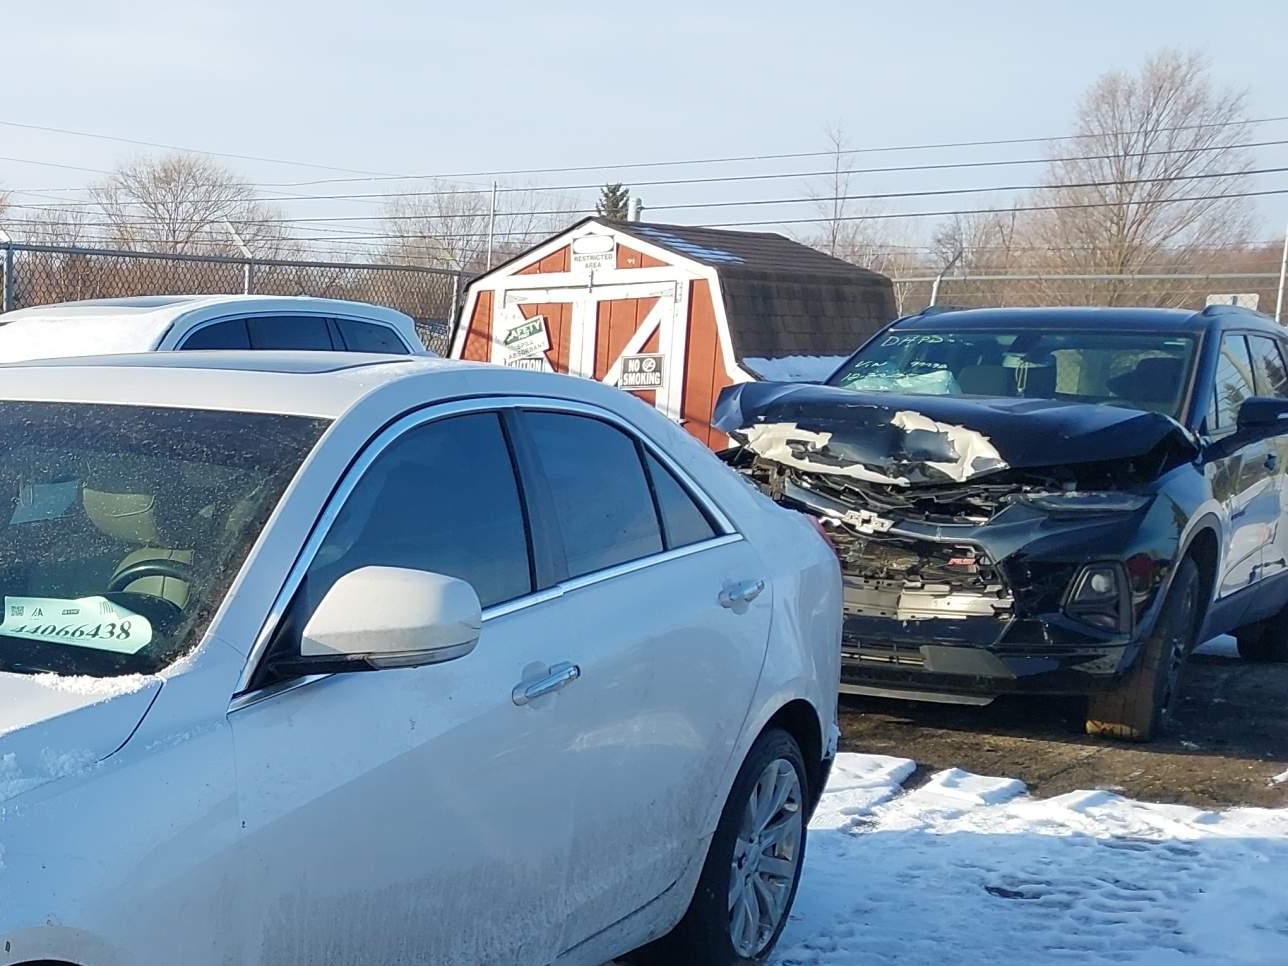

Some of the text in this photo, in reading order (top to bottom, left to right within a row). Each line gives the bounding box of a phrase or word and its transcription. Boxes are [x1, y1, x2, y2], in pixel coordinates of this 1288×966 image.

[574, 253, 613, 262] RESTRICTED
[628, 358, 640, 372] NO
[623, 372, 661, 387] SMOKING
